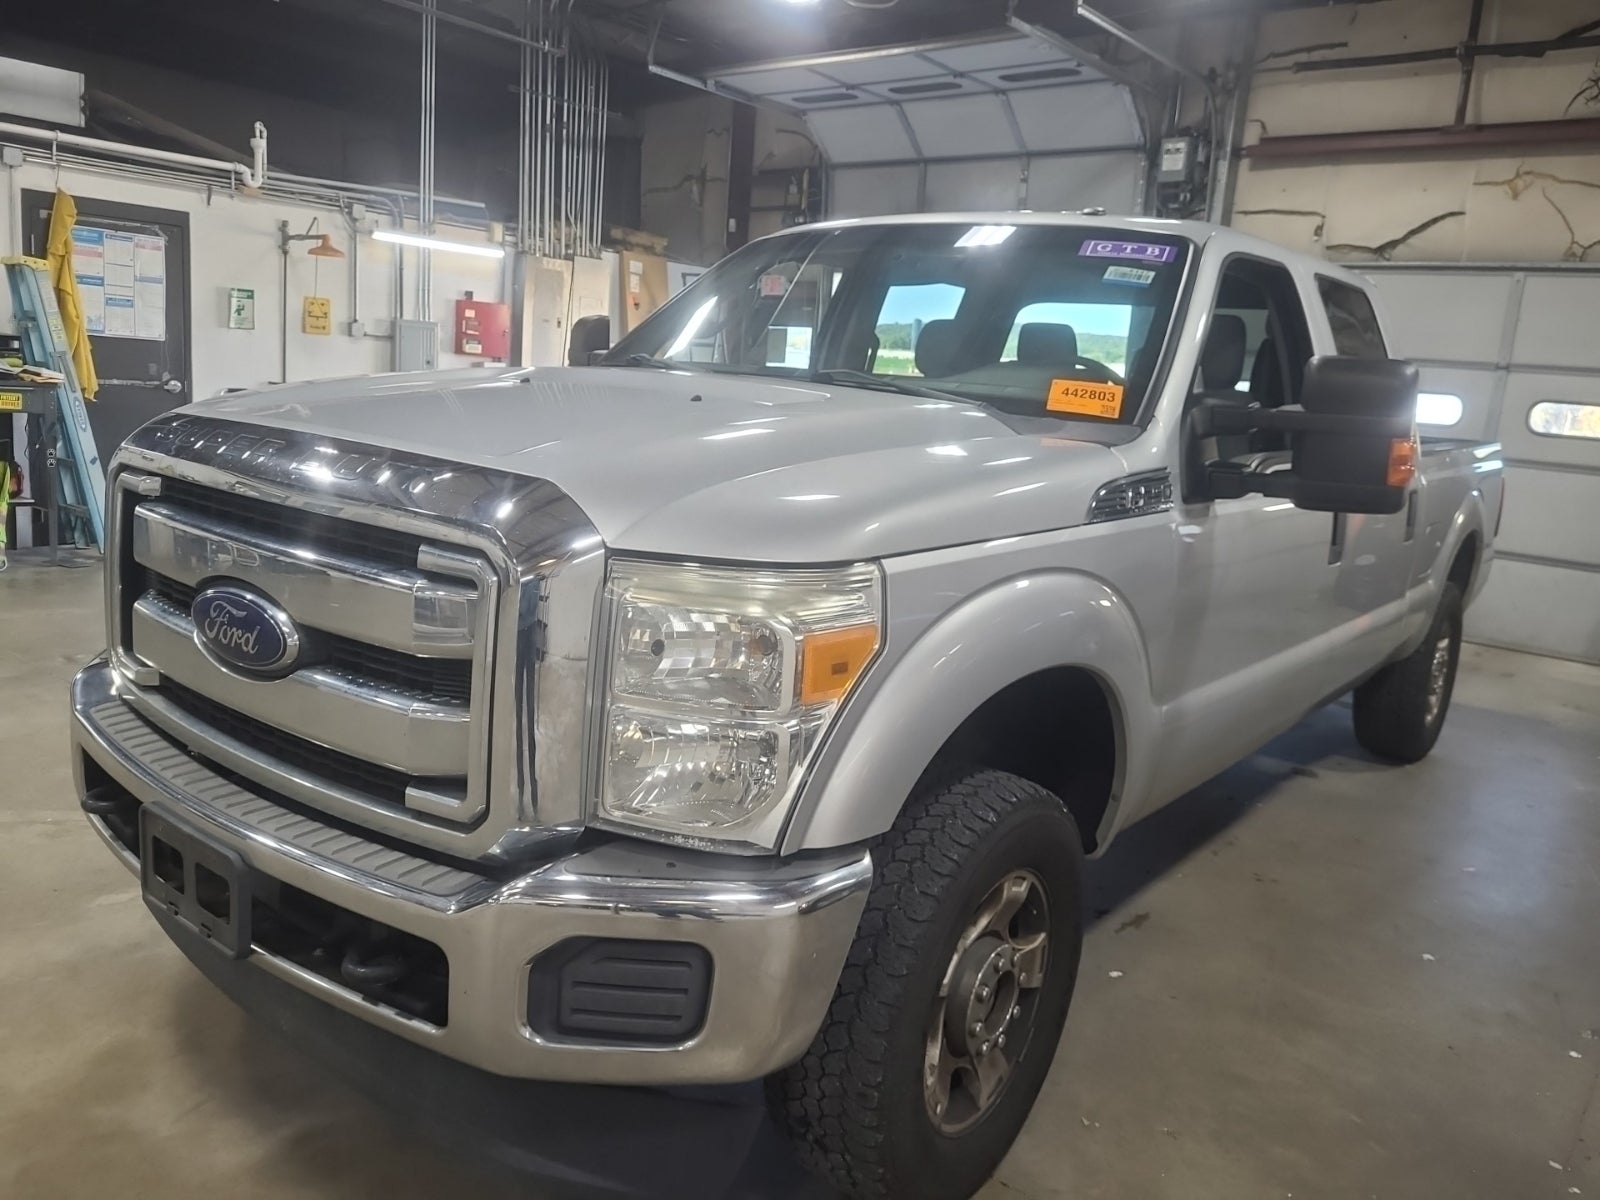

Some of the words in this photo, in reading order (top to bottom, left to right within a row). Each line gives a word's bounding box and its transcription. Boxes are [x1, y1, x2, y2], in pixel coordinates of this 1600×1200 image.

[1061, 387, 1116, 403] 442803
[156, 421, 286, 464] SUPER
[204, 599, 259, 656] Ford
